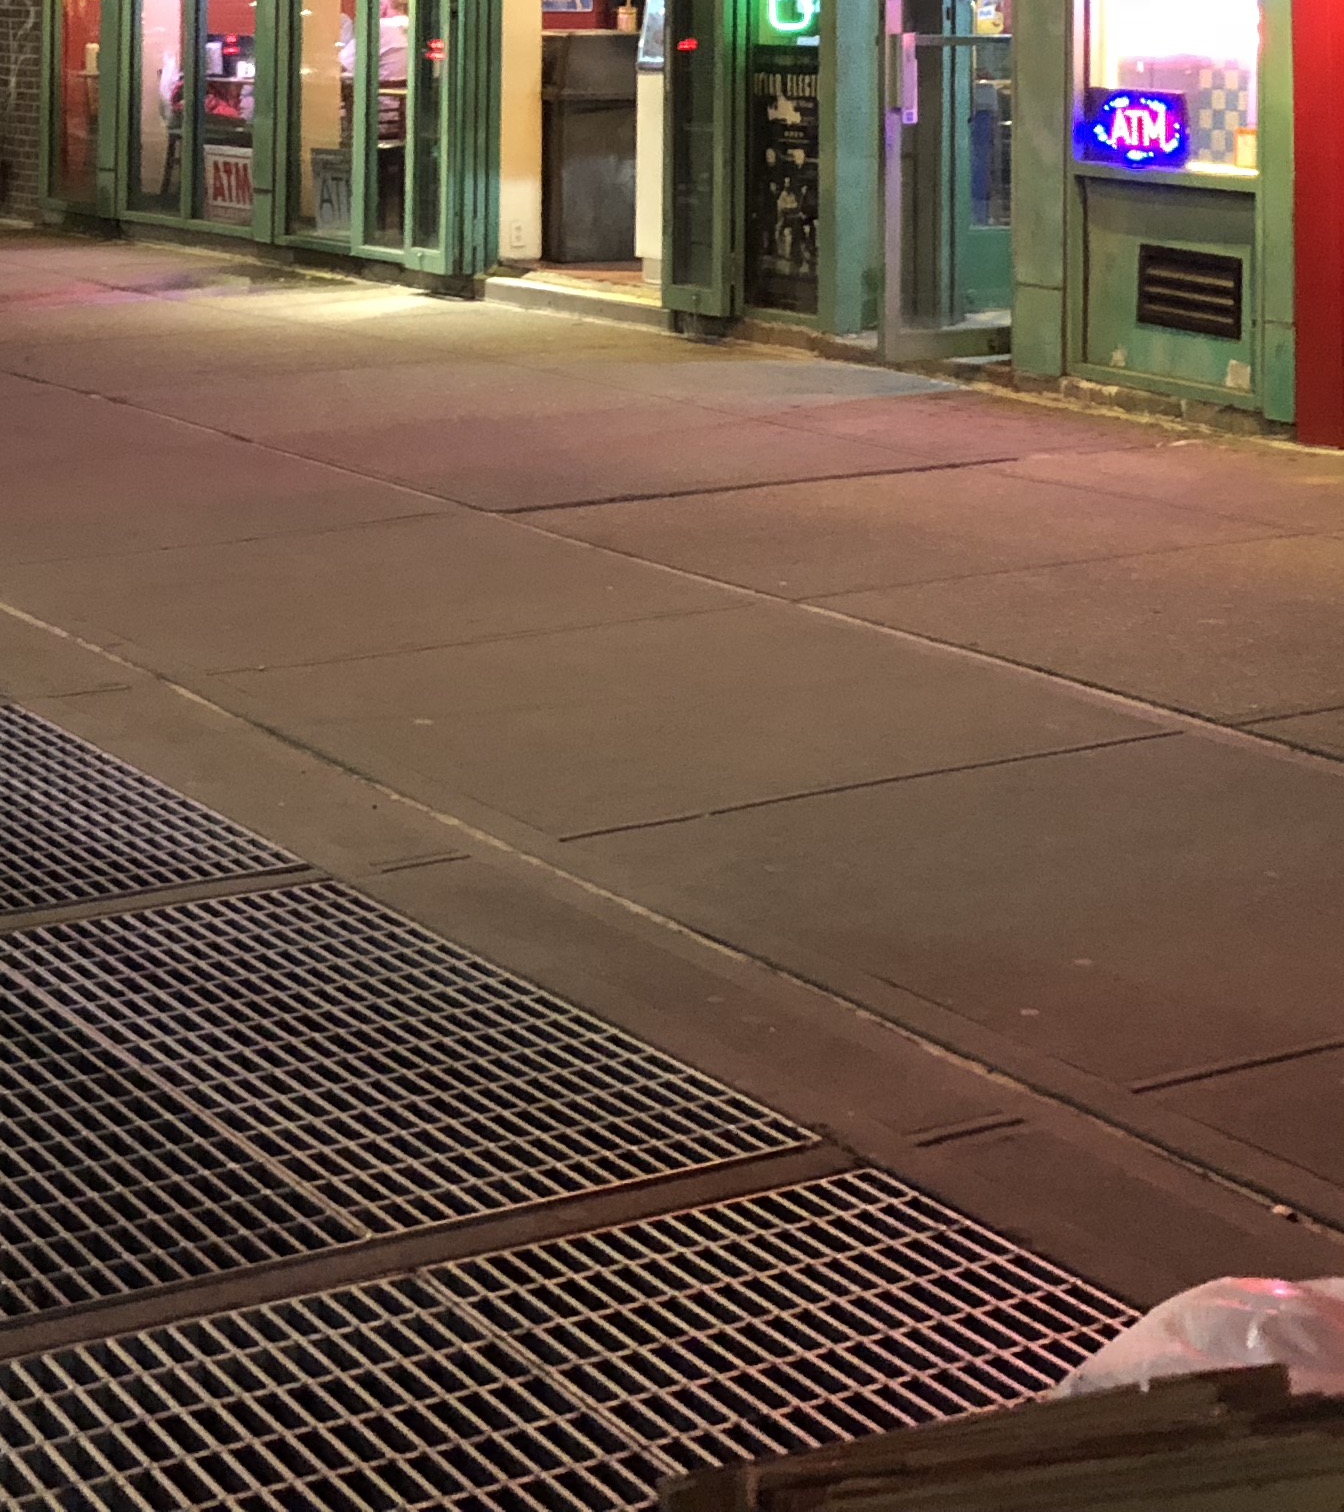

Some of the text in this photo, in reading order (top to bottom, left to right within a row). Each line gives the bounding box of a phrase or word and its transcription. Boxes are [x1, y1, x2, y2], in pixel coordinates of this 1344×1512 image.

[1111, 109, 1168, 148] ATM
[212, 159, 254, 205] ATM
[319, 176, 351, 216] AT
